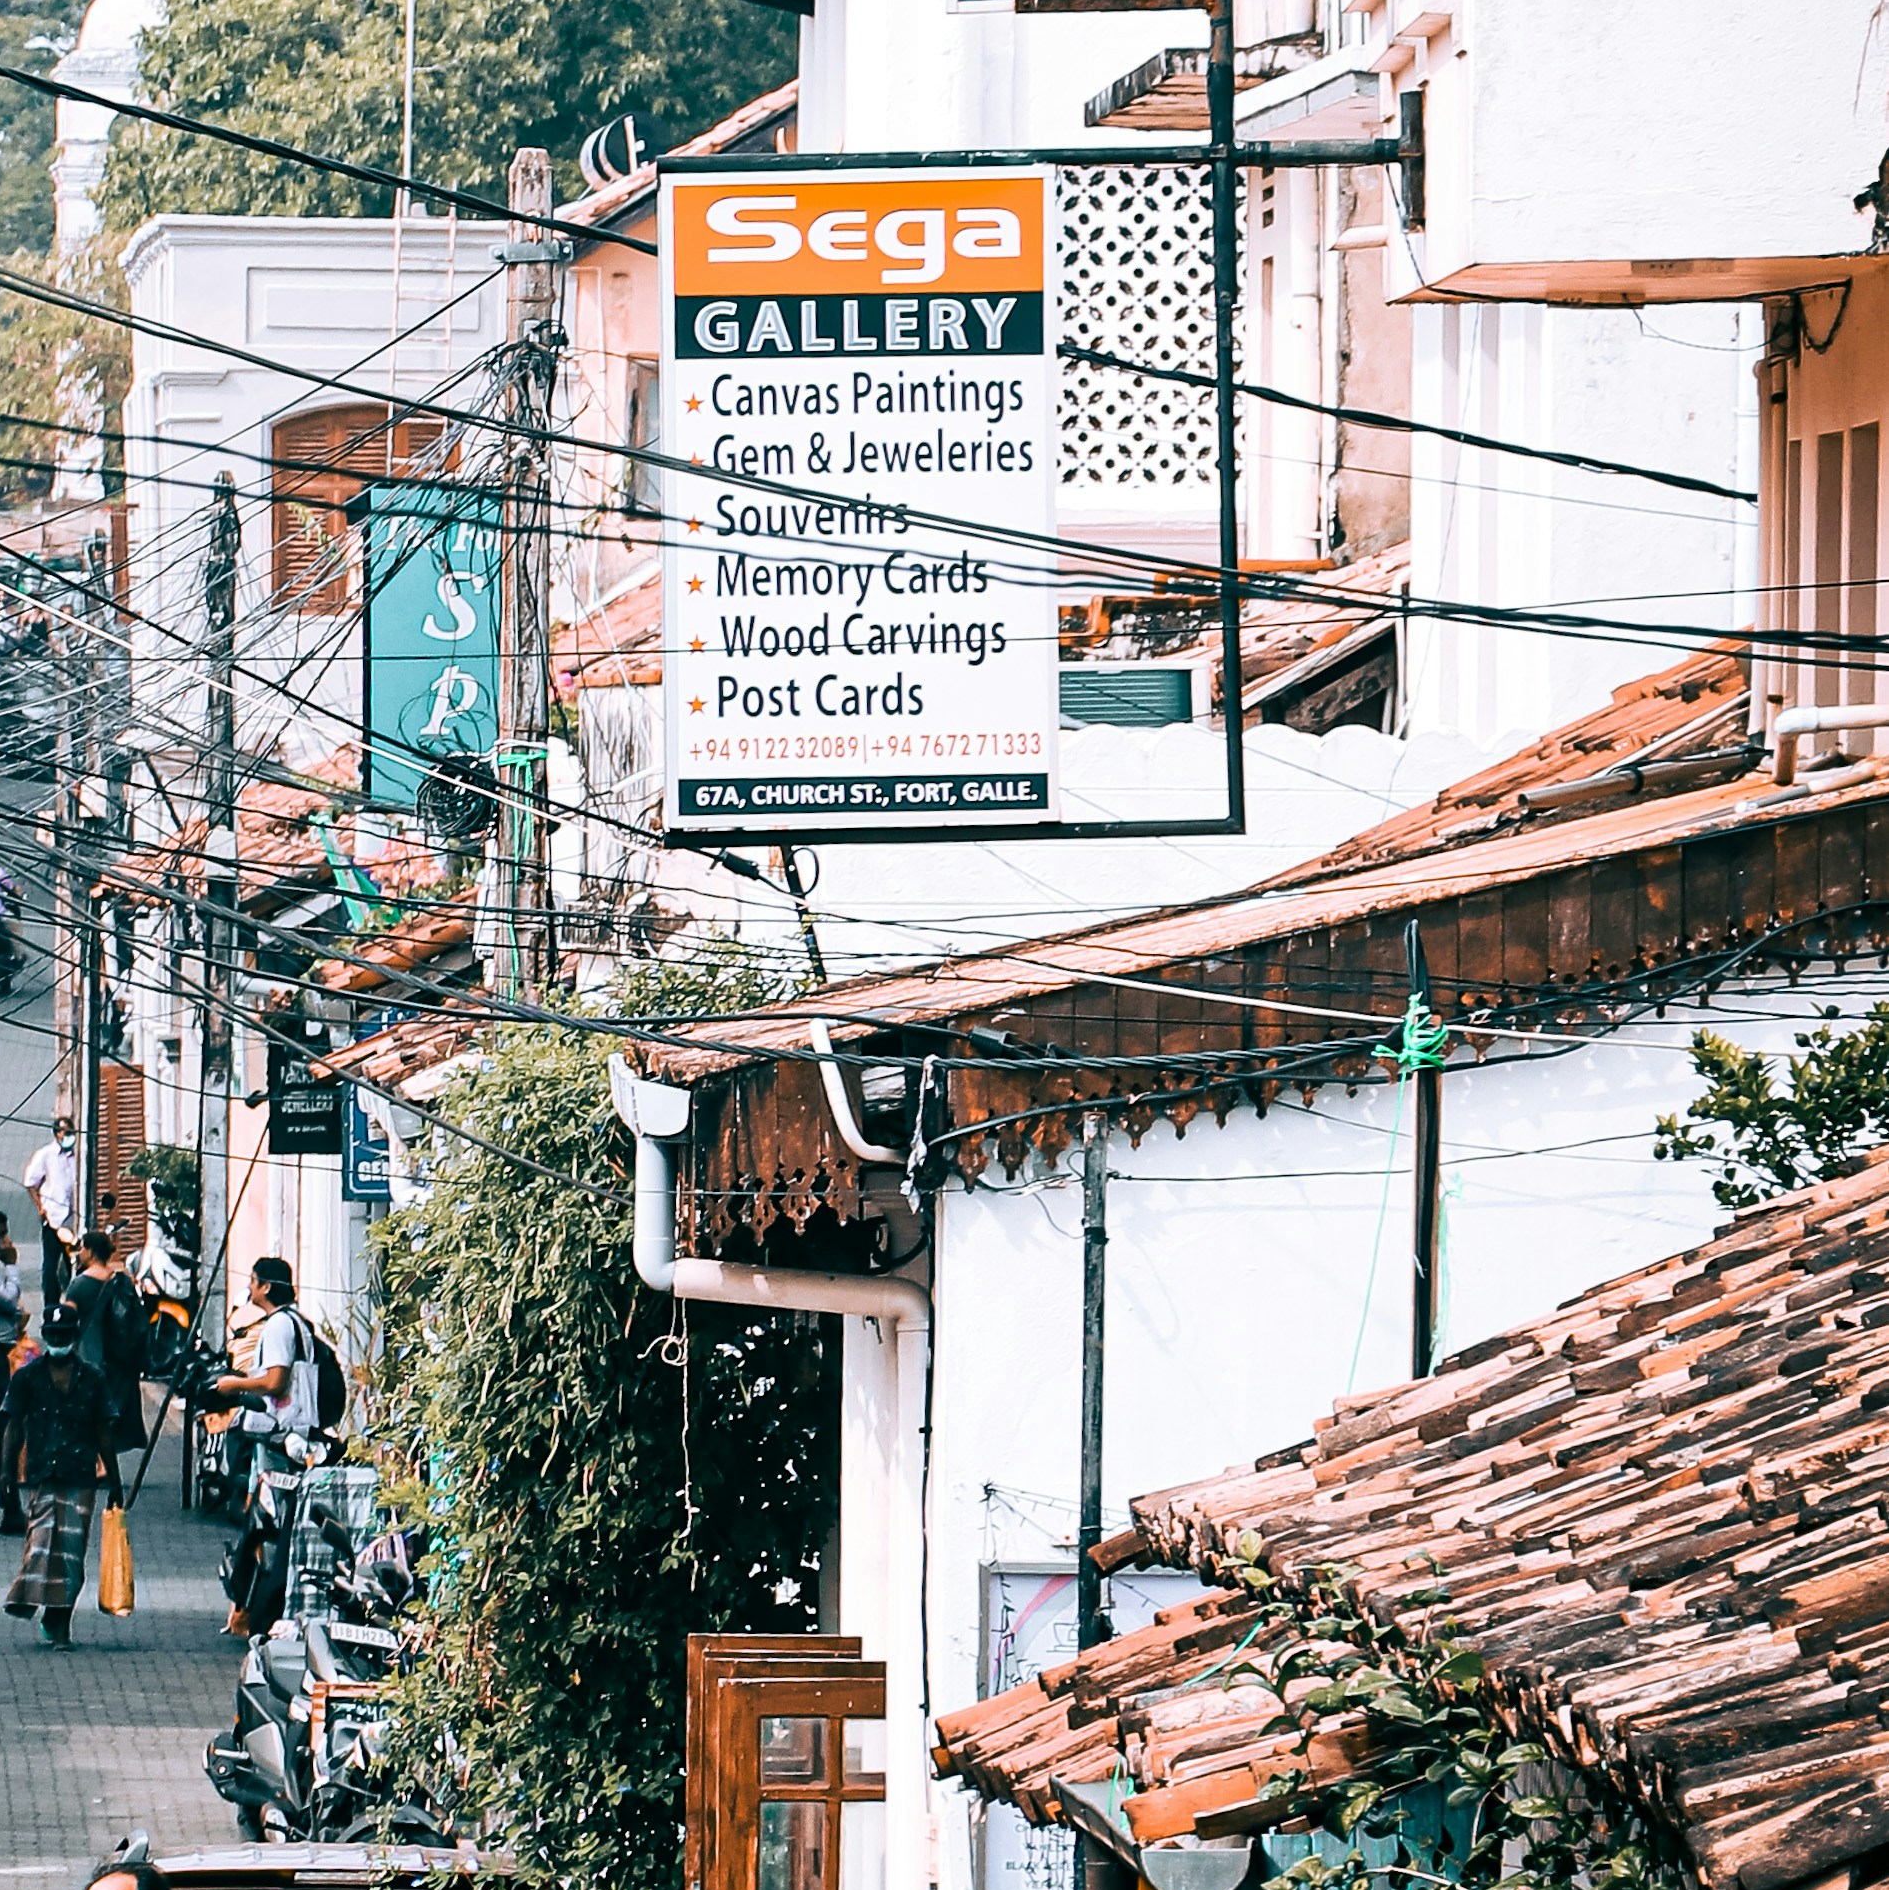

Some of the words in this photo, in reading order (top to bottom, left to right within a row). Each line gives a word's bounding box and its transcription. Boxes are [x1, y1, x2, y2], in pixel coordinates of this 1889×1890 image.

[705, 194, 1021, 285] Sega
[694, 298, 1017, 354] GALLERY
[711, 373, 839, 416] Canvas
[853, 370, 1023, 423] Paintings
[713, 434, 794, 477] Gem
[808, 432, 831, 474] &
[844, 428, 1033, 474] Jeweleries
[717, 553, 872, 607] Memory
[884, 550, 987, 594] Cards
[721, 613, 828, 657] Wood
[844, 612, 1006, 665] Carvings
[717, 675, 800, 718] Post
[816, 672, 923, 716] Cards
[696, 786, 747, 809] 67A,
[751, 784, 845, 806] CHURCH
[895, 782, 957, 805] FORT,
[962, 780, 1038, 802] GALLE.
